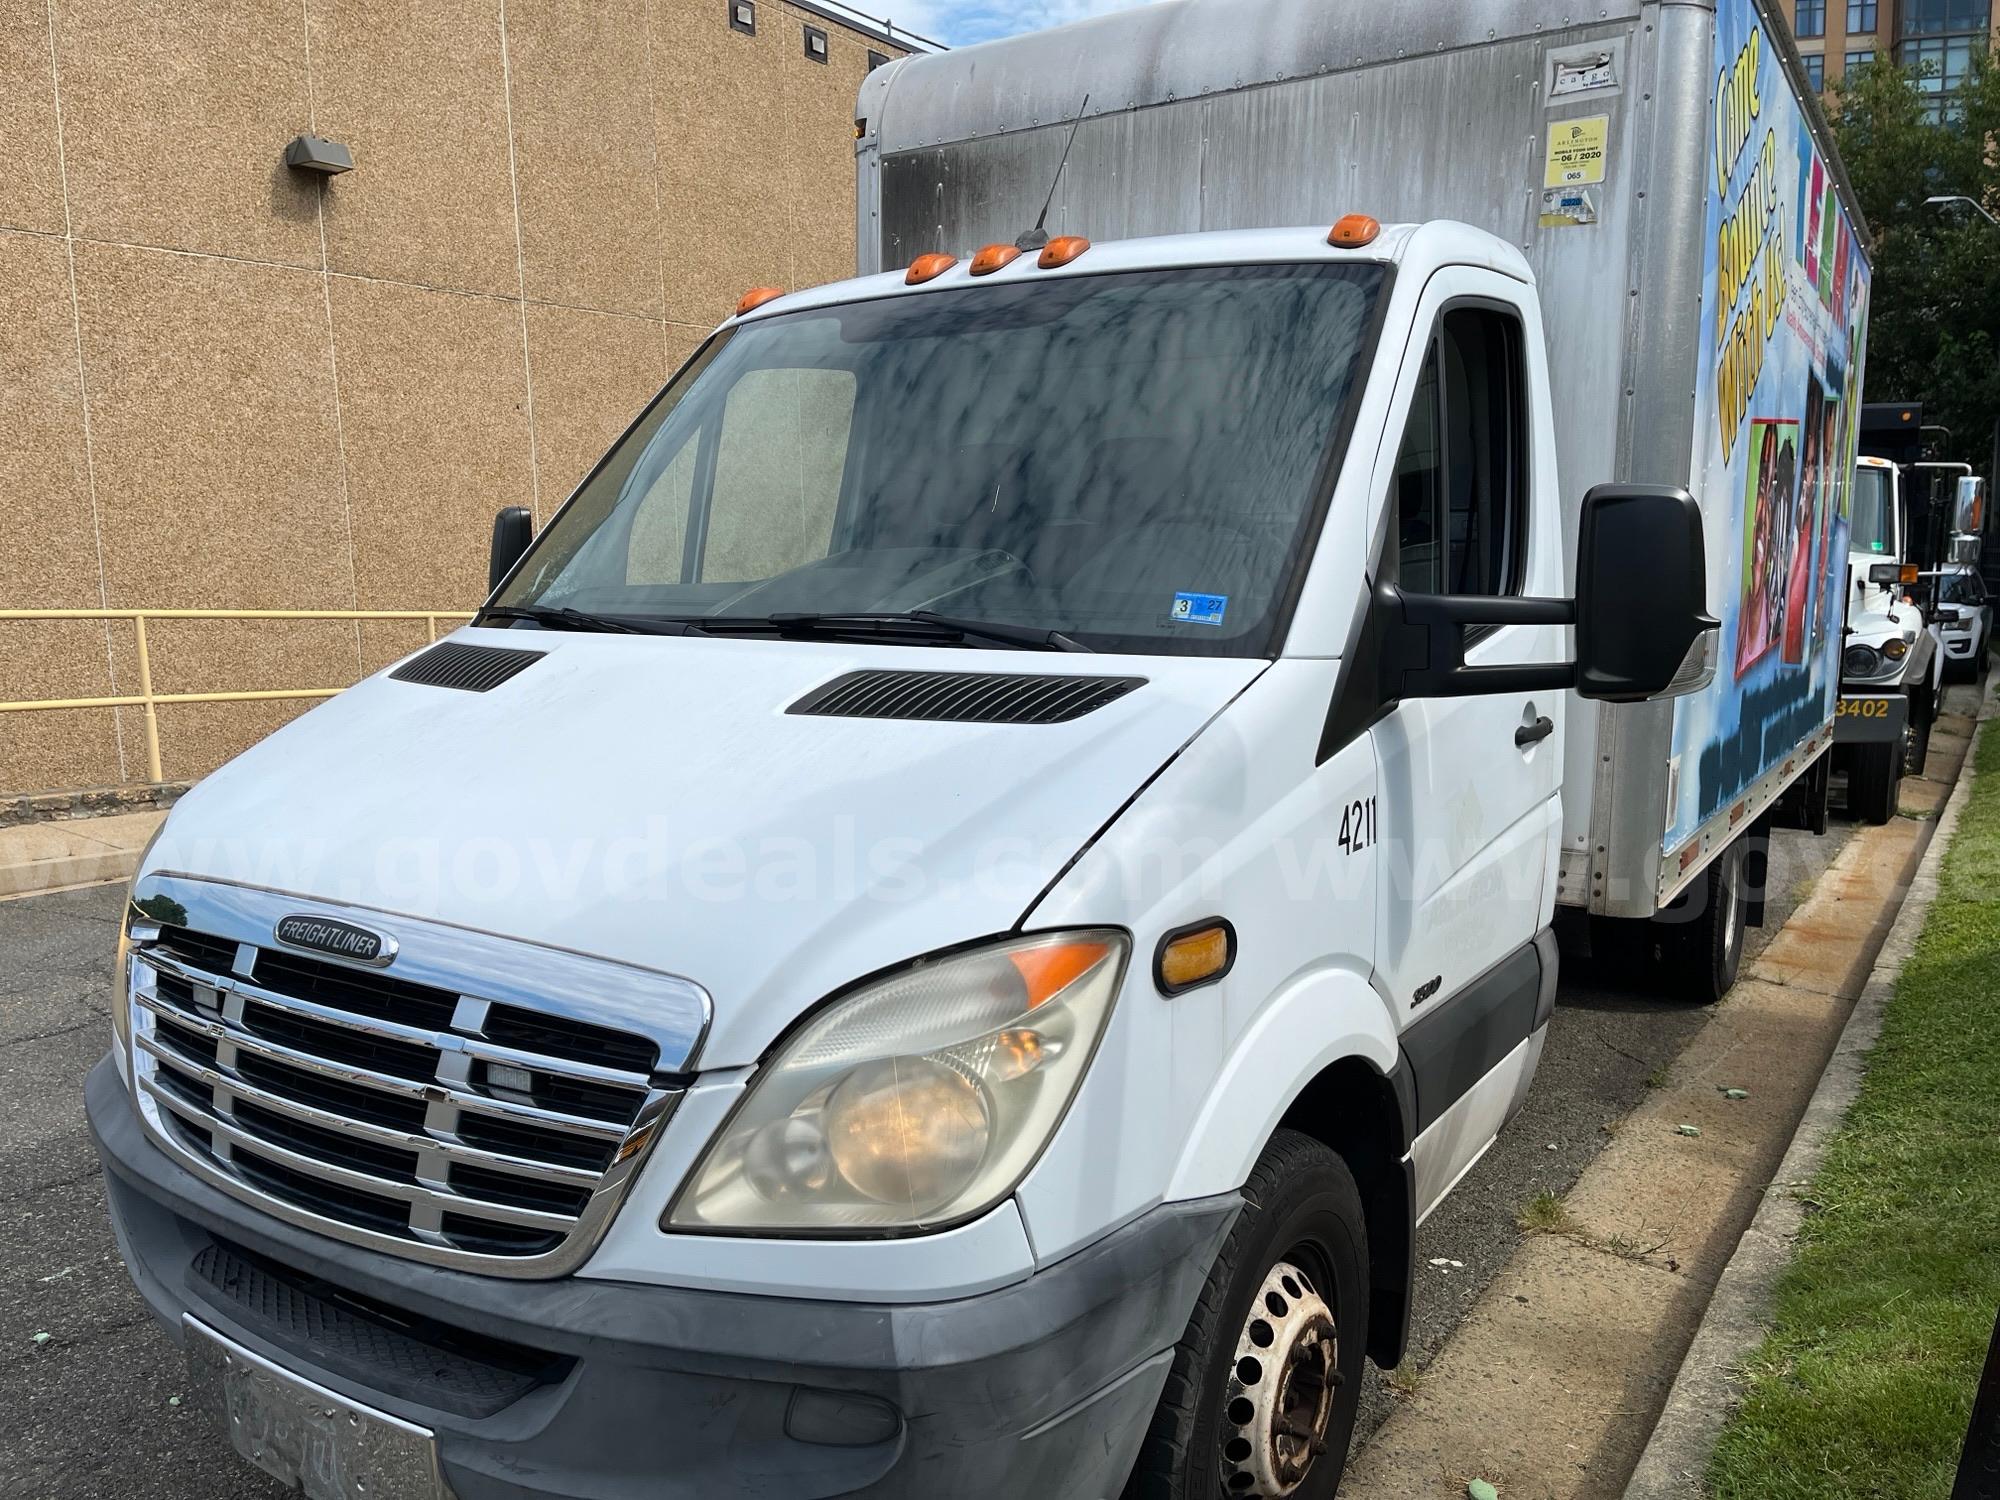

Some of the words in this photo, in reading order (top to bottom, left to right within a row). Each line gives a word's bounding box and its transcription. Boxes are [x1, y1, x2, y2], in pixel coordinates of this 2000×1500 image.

[1560, 70, 1610, 85] cargo
[1716, 25, 1760, 203] Come
[1561, 154, 1572, 162] 06
[1579, 151, 1602, 160] 2020
[1717, 127, 1776, 352] Bounce
[1717, 275, 1764, 469] With
[1180, 600, 1188, 612] 3
[1207, 600, 1223, 611] 27
[1338, 795, 1377, 856] 4211
[280, 920, 377, 955] FREIGHTLINER
